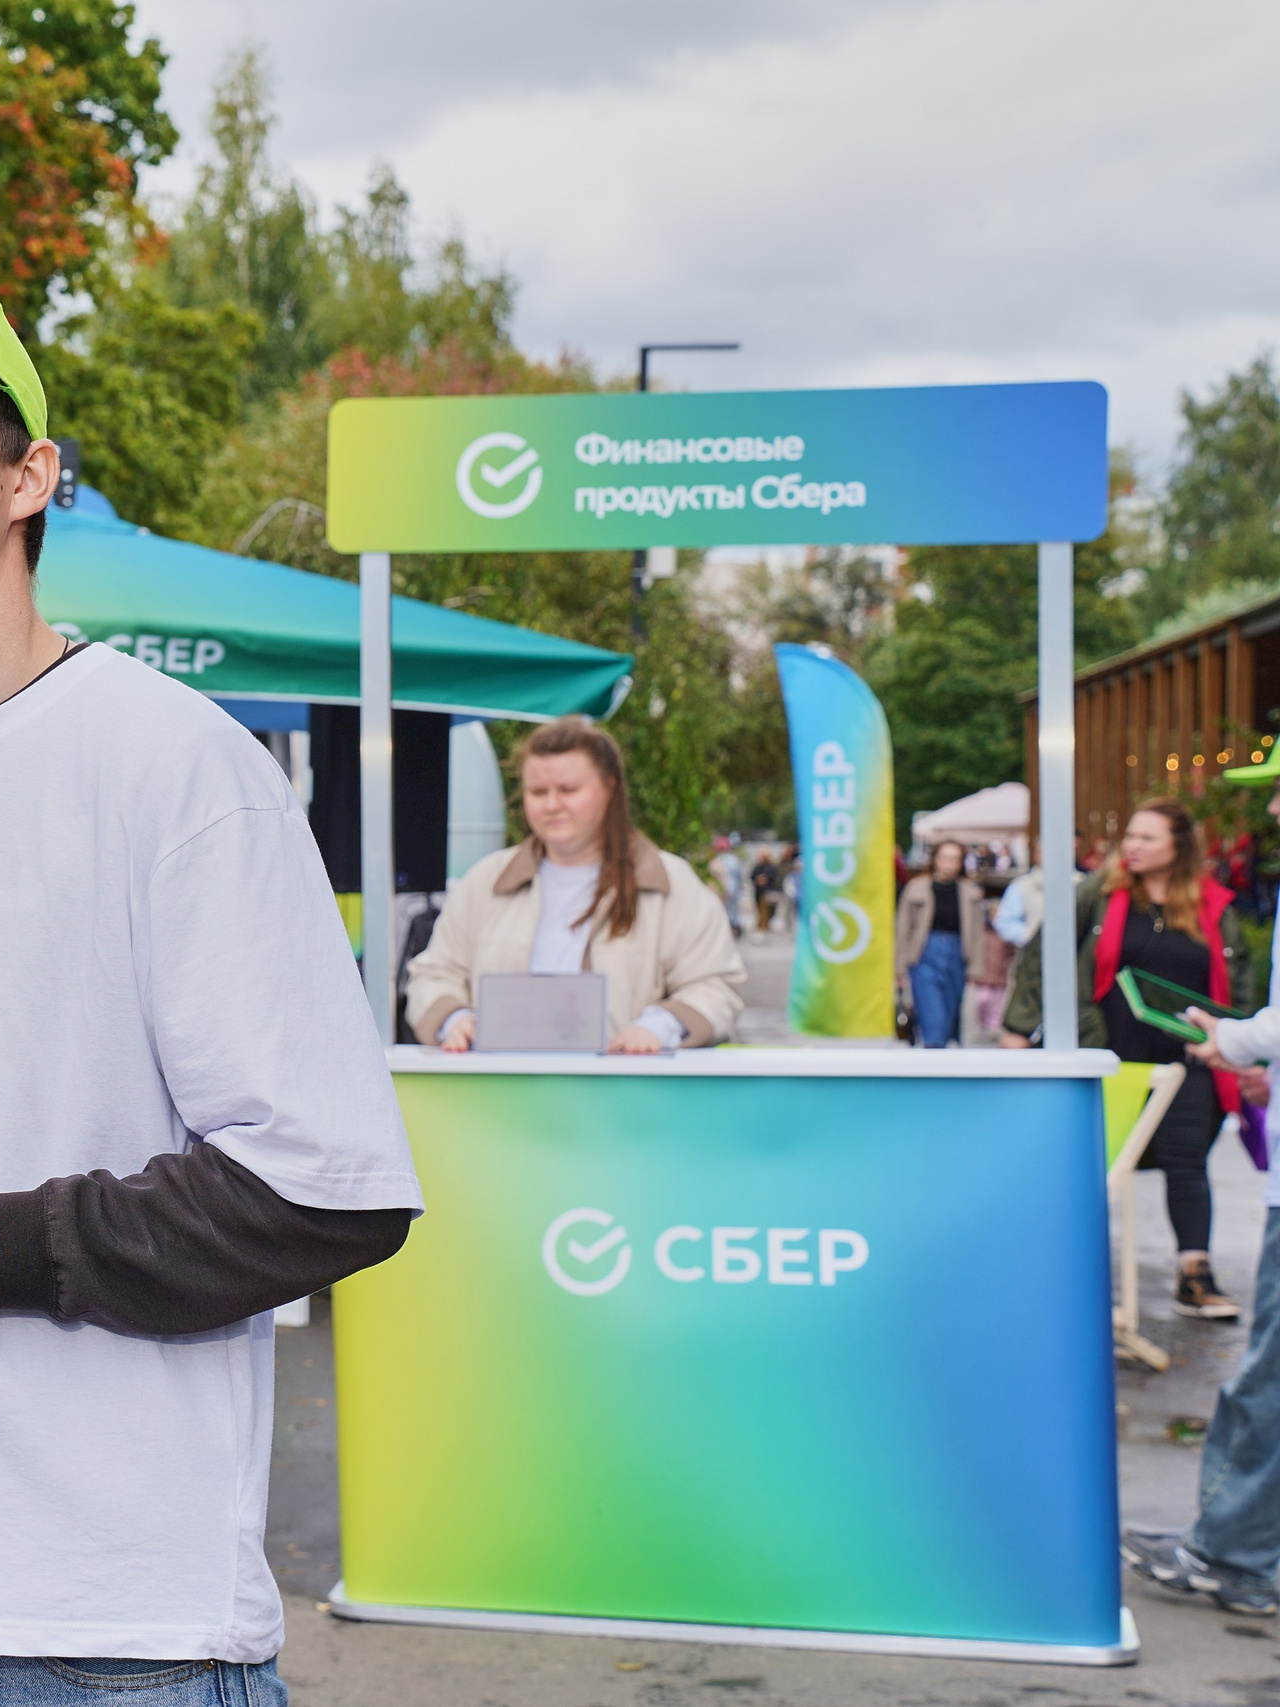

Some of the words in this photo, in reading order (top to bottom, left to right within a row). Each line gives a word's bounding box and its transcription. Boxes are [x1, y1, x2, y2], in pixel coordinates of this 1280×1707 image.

[575, 432, 805, 466] Финансовые
[575, 484, 746, 519] продукты
[751, 473, 866, 515] Сбера
[813, 741, 856, 887] СБЕР
[654, 1225, 869, 1287] СБЕР
